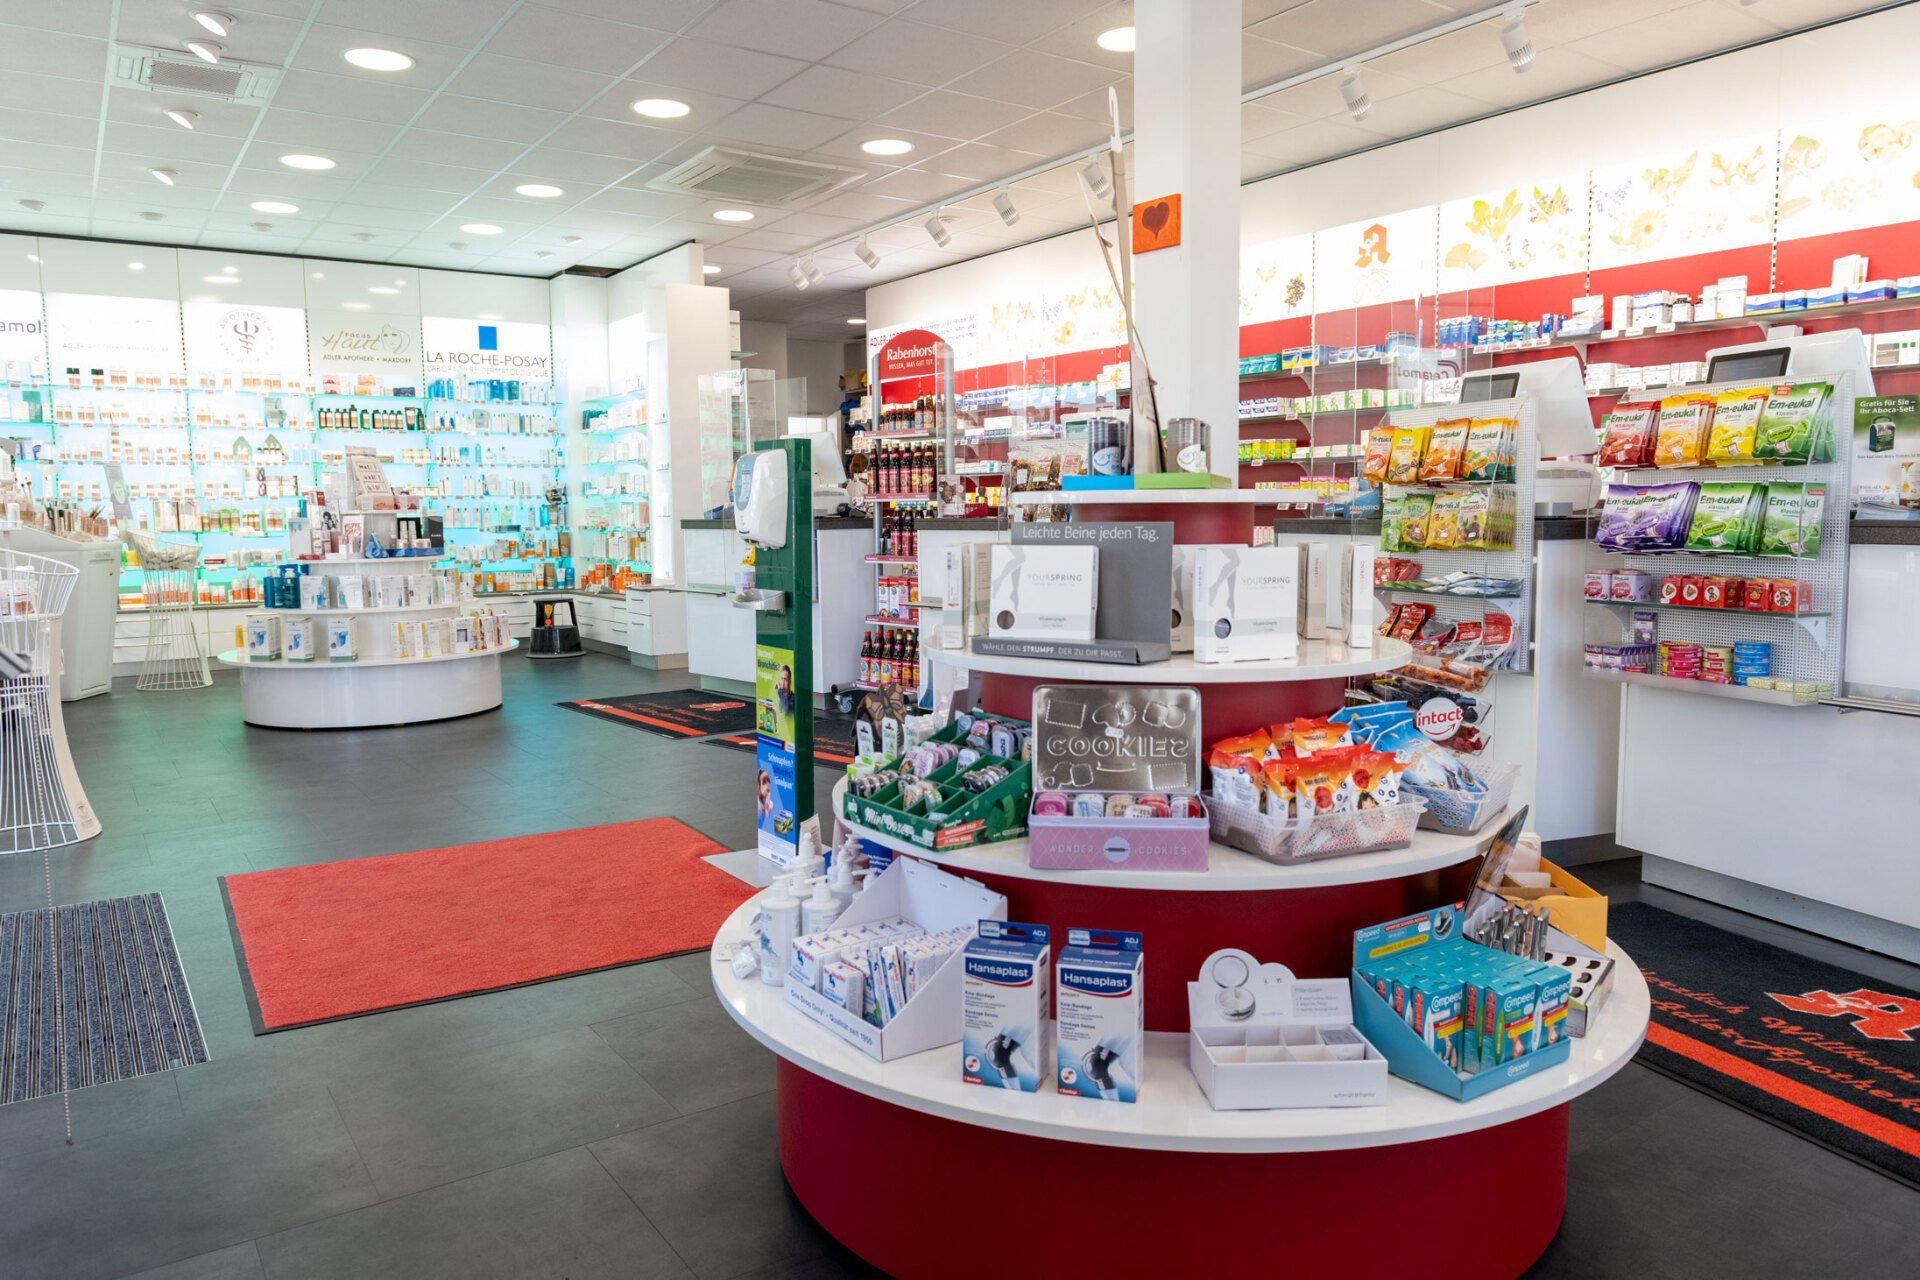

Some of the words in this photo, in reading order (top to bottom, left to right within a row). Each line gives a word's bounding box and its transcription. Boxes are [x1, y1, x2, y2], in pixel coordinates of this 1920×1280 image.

[322, 330, 382, 351] Haut
[323, 353, 342, 362] ADLER
[887, 344, 937, 361] Rabenhorst
[426, 352, 444, 363] LA
[449, 353, 547, 368] ROCHE-POSAY
[1716, 402, 1757, 415] Em-eukal
[1767, 398, 1816, 410] Em-eukal
[1872, 405, 1915, 414] Aboca-Set!
[1661, 408, 1695, 420] Em-eukal
[1700, 495, 1744, 505] Em-eukal
[1769, 497, 1819, 508] Em-eukal
[1023, 526, 1061, 540] Leichte
[1064, 526, 1096, 540] Beine
[1098, 526, 1132, 542] jeden
[1135, 526, 1160, 542] Tag.
[1028, 573, 1083, 582] YOURSPRING
[1241, 576, 1291, 585] YOURSPRING
[982, 642, 1005, 651] WÄHLE
[1006, 644, 1022, 652] DEN
[1058, 647, 1072, 655] DER
[1074, 648, 1084, 656] ZU
[1085, 649, 1098, 657] DIR
[1100, 650, 1124, 659] PASST.
[1416, 707, 1462, 727] intact
[1050, 845, 1094, 854] WONDER
[1138, 846, 1187, 856] COOKIES
[1032, 929, 1047, 937] ADJ
[1124, 937, 1139, 945] ADJ
[968, 962, 1029, 978] Hansaplast
[1064, 973, 1128, 988] Hansaplast
[1542, 980, 1571, 1002] Compeed
[1431, 989, 1463, 1012] Compeed
[1503, 991, 1535, 1013] Compeed
